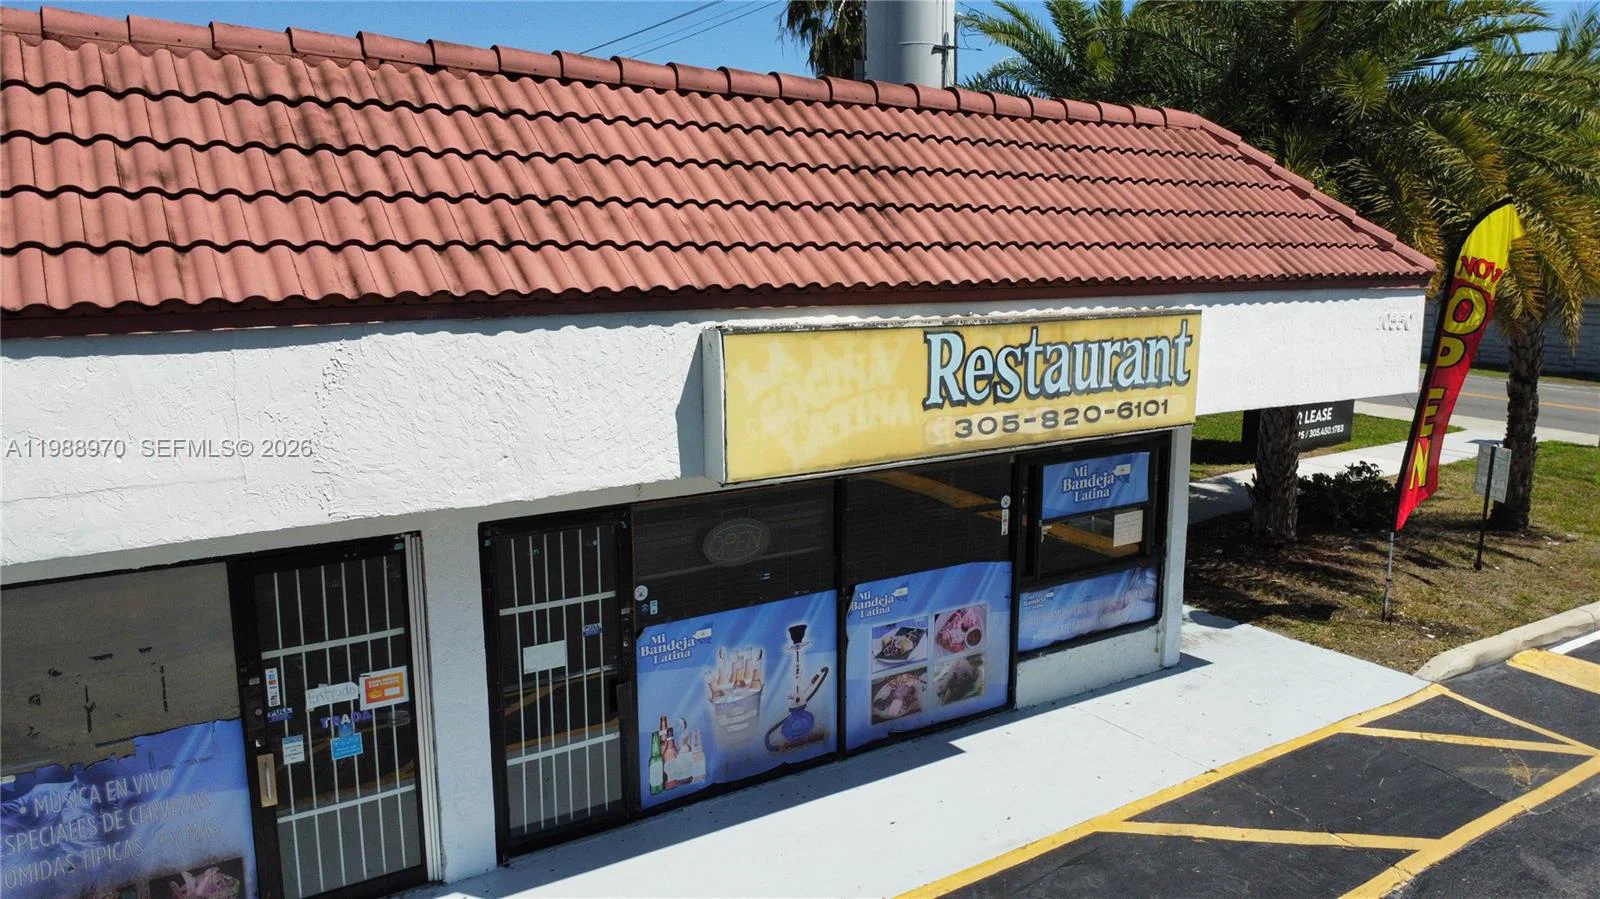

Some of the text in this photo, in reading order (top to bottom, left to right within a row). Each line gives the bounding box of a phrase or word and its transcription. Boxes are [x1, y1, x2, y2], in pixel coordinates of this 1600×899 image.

[922, 318, 1194, 411] Restaurant
[1410, 285, 1490, 490] OPEN
[954, 399, 1169, 439] 305-820-6101
[1304, 407, 1334, 424] LEASE
[1074, 465, 1088, 477] Mi
[1062, 473, 1115, 493] Bandeja
[1074, 488, 1110, 502] Latina
[850, 595, 894, 611] Bandeja
[860, 590, 871, 600] Mi
[860, 606, 890, 618] Latina
[641, 637, 696, 657] Bandeja
[651, 633, 666, 645] Mi
[654, 650, 691, 664] Latina
[105, 777, 128, 801] EN
[133, 769, 173, 794] VIVO
[1, 790, 211, 857] SPECIALES DE CERVEZAS
[4, 853, 76, 889] OMIDAS
